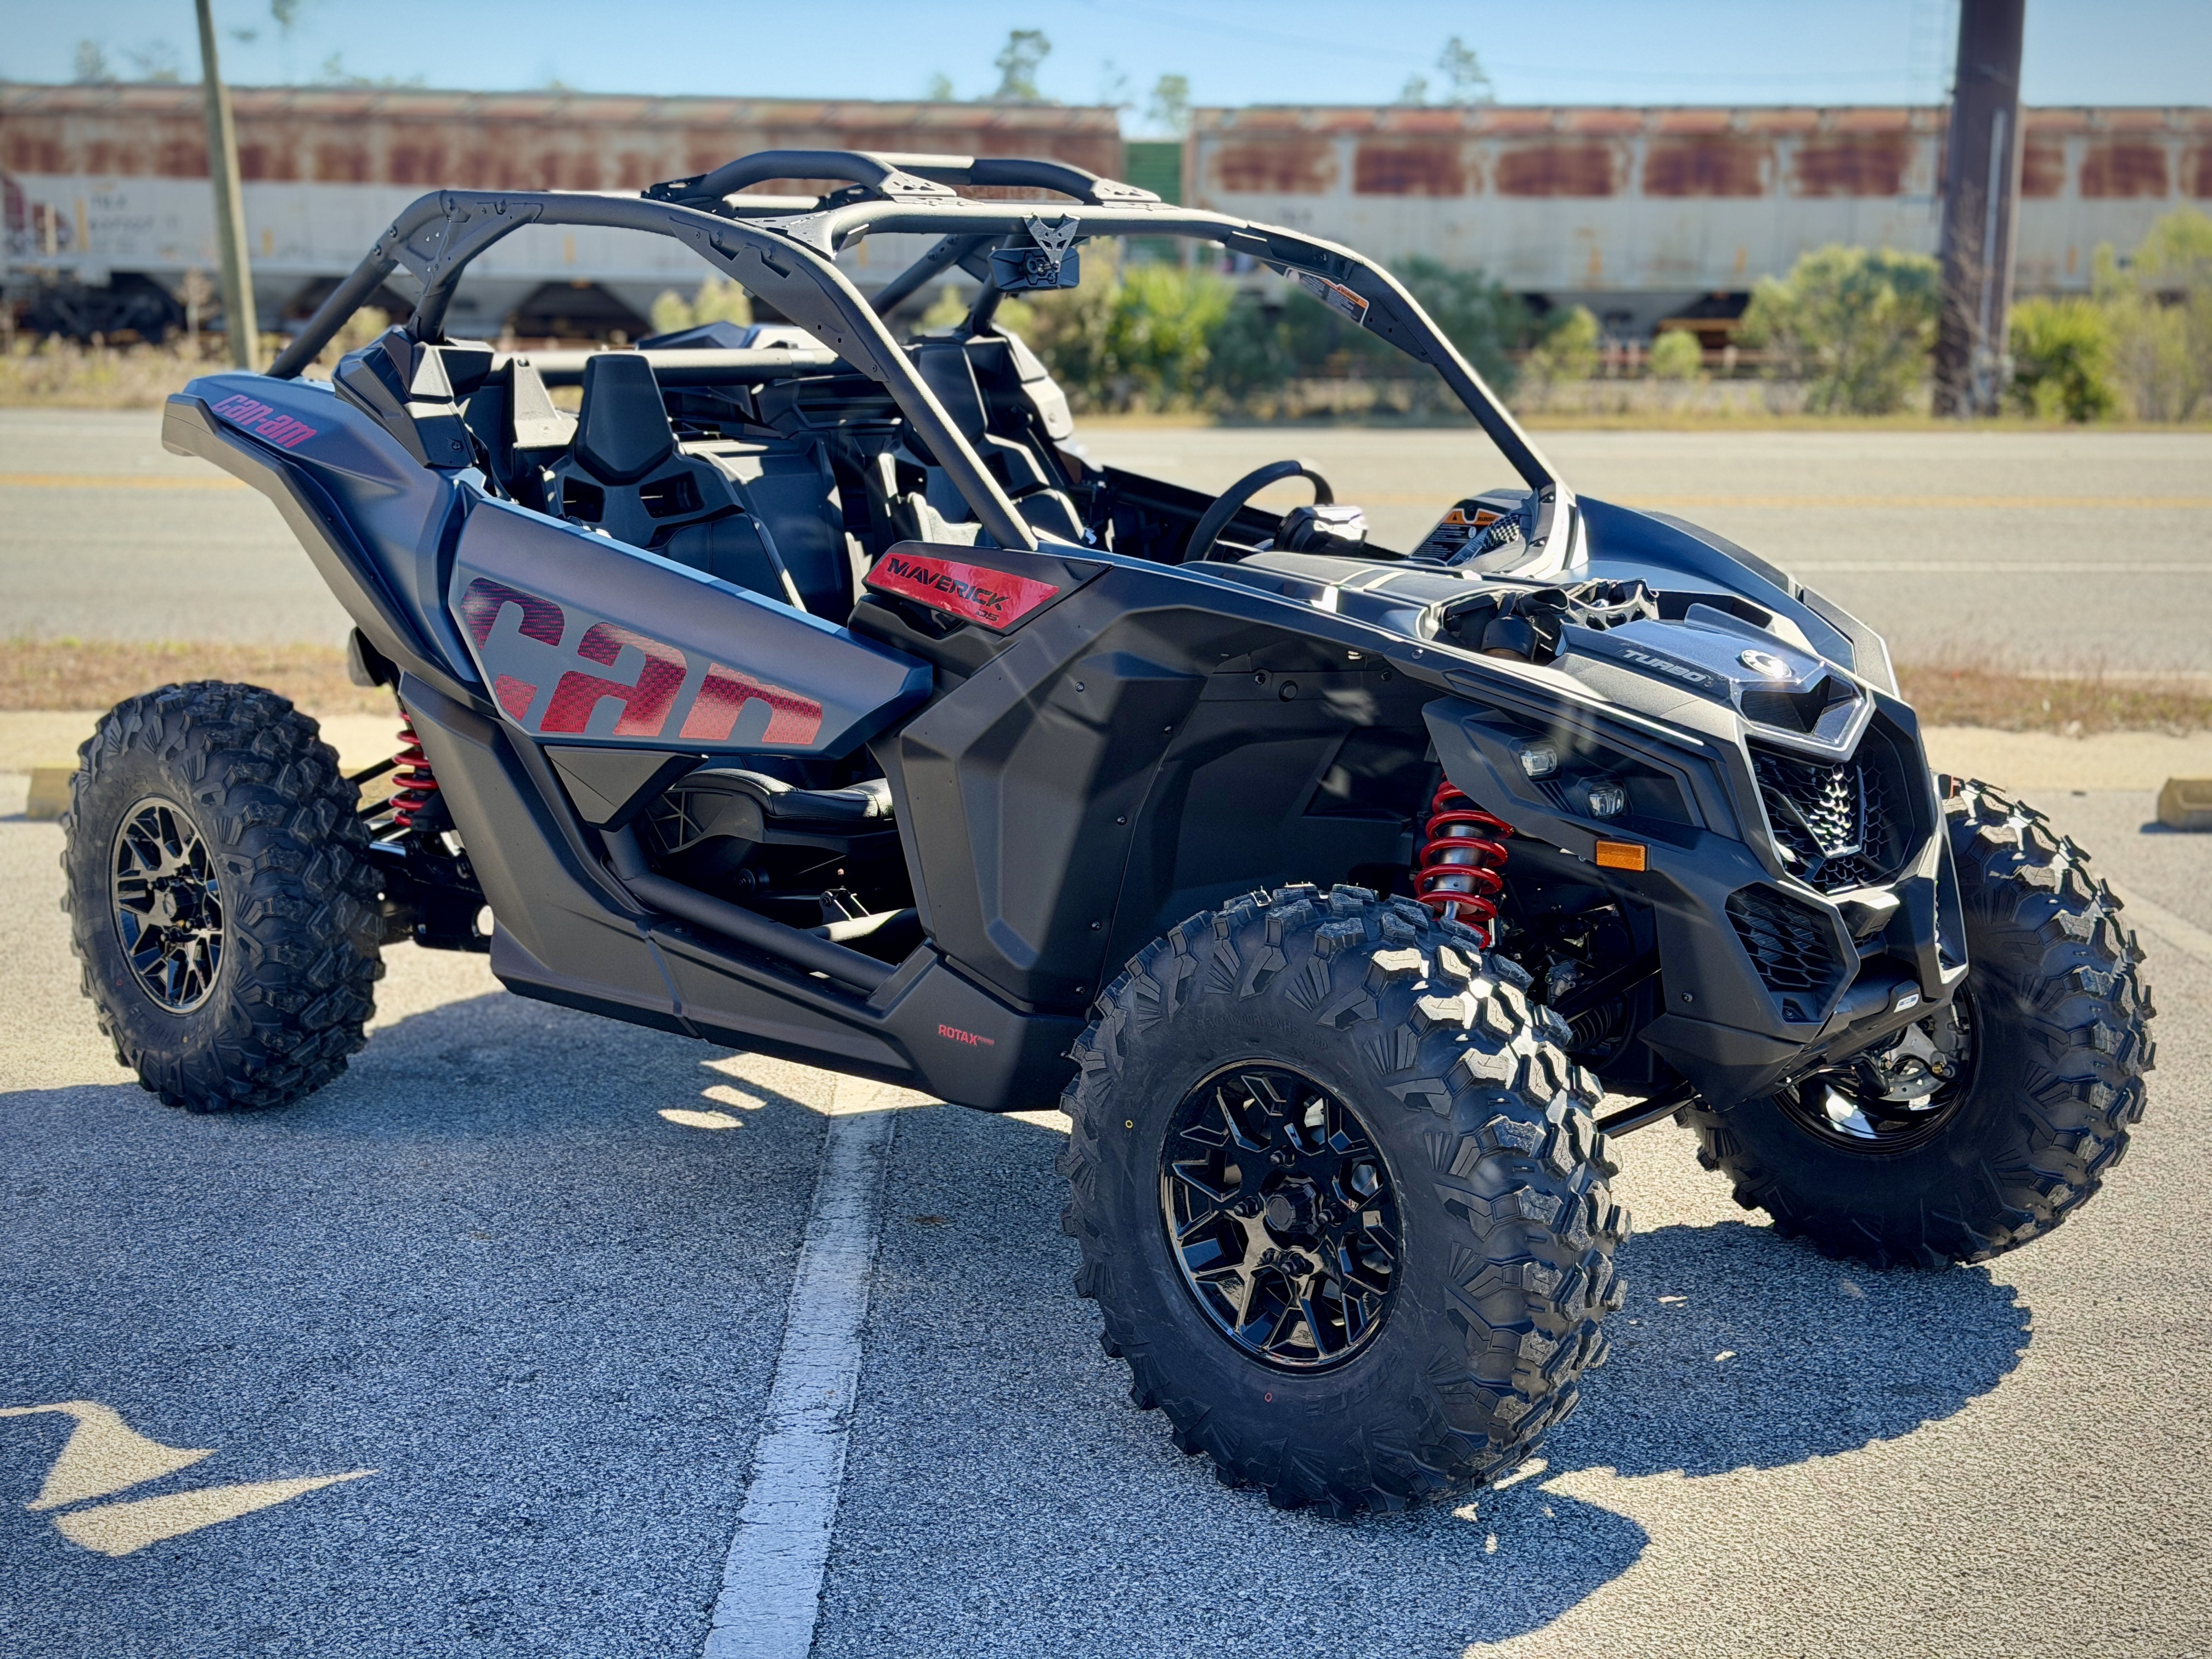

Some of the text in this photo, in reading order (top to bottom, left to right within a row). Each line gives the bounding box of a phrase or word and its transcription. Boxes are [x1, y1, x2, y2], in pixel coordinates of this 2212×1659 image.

[887, 557, 1010, 611] MAVERICK
[1622, 650, 1707, 682] TURBO
[939, 1024, 977, 1045] ROTAX
